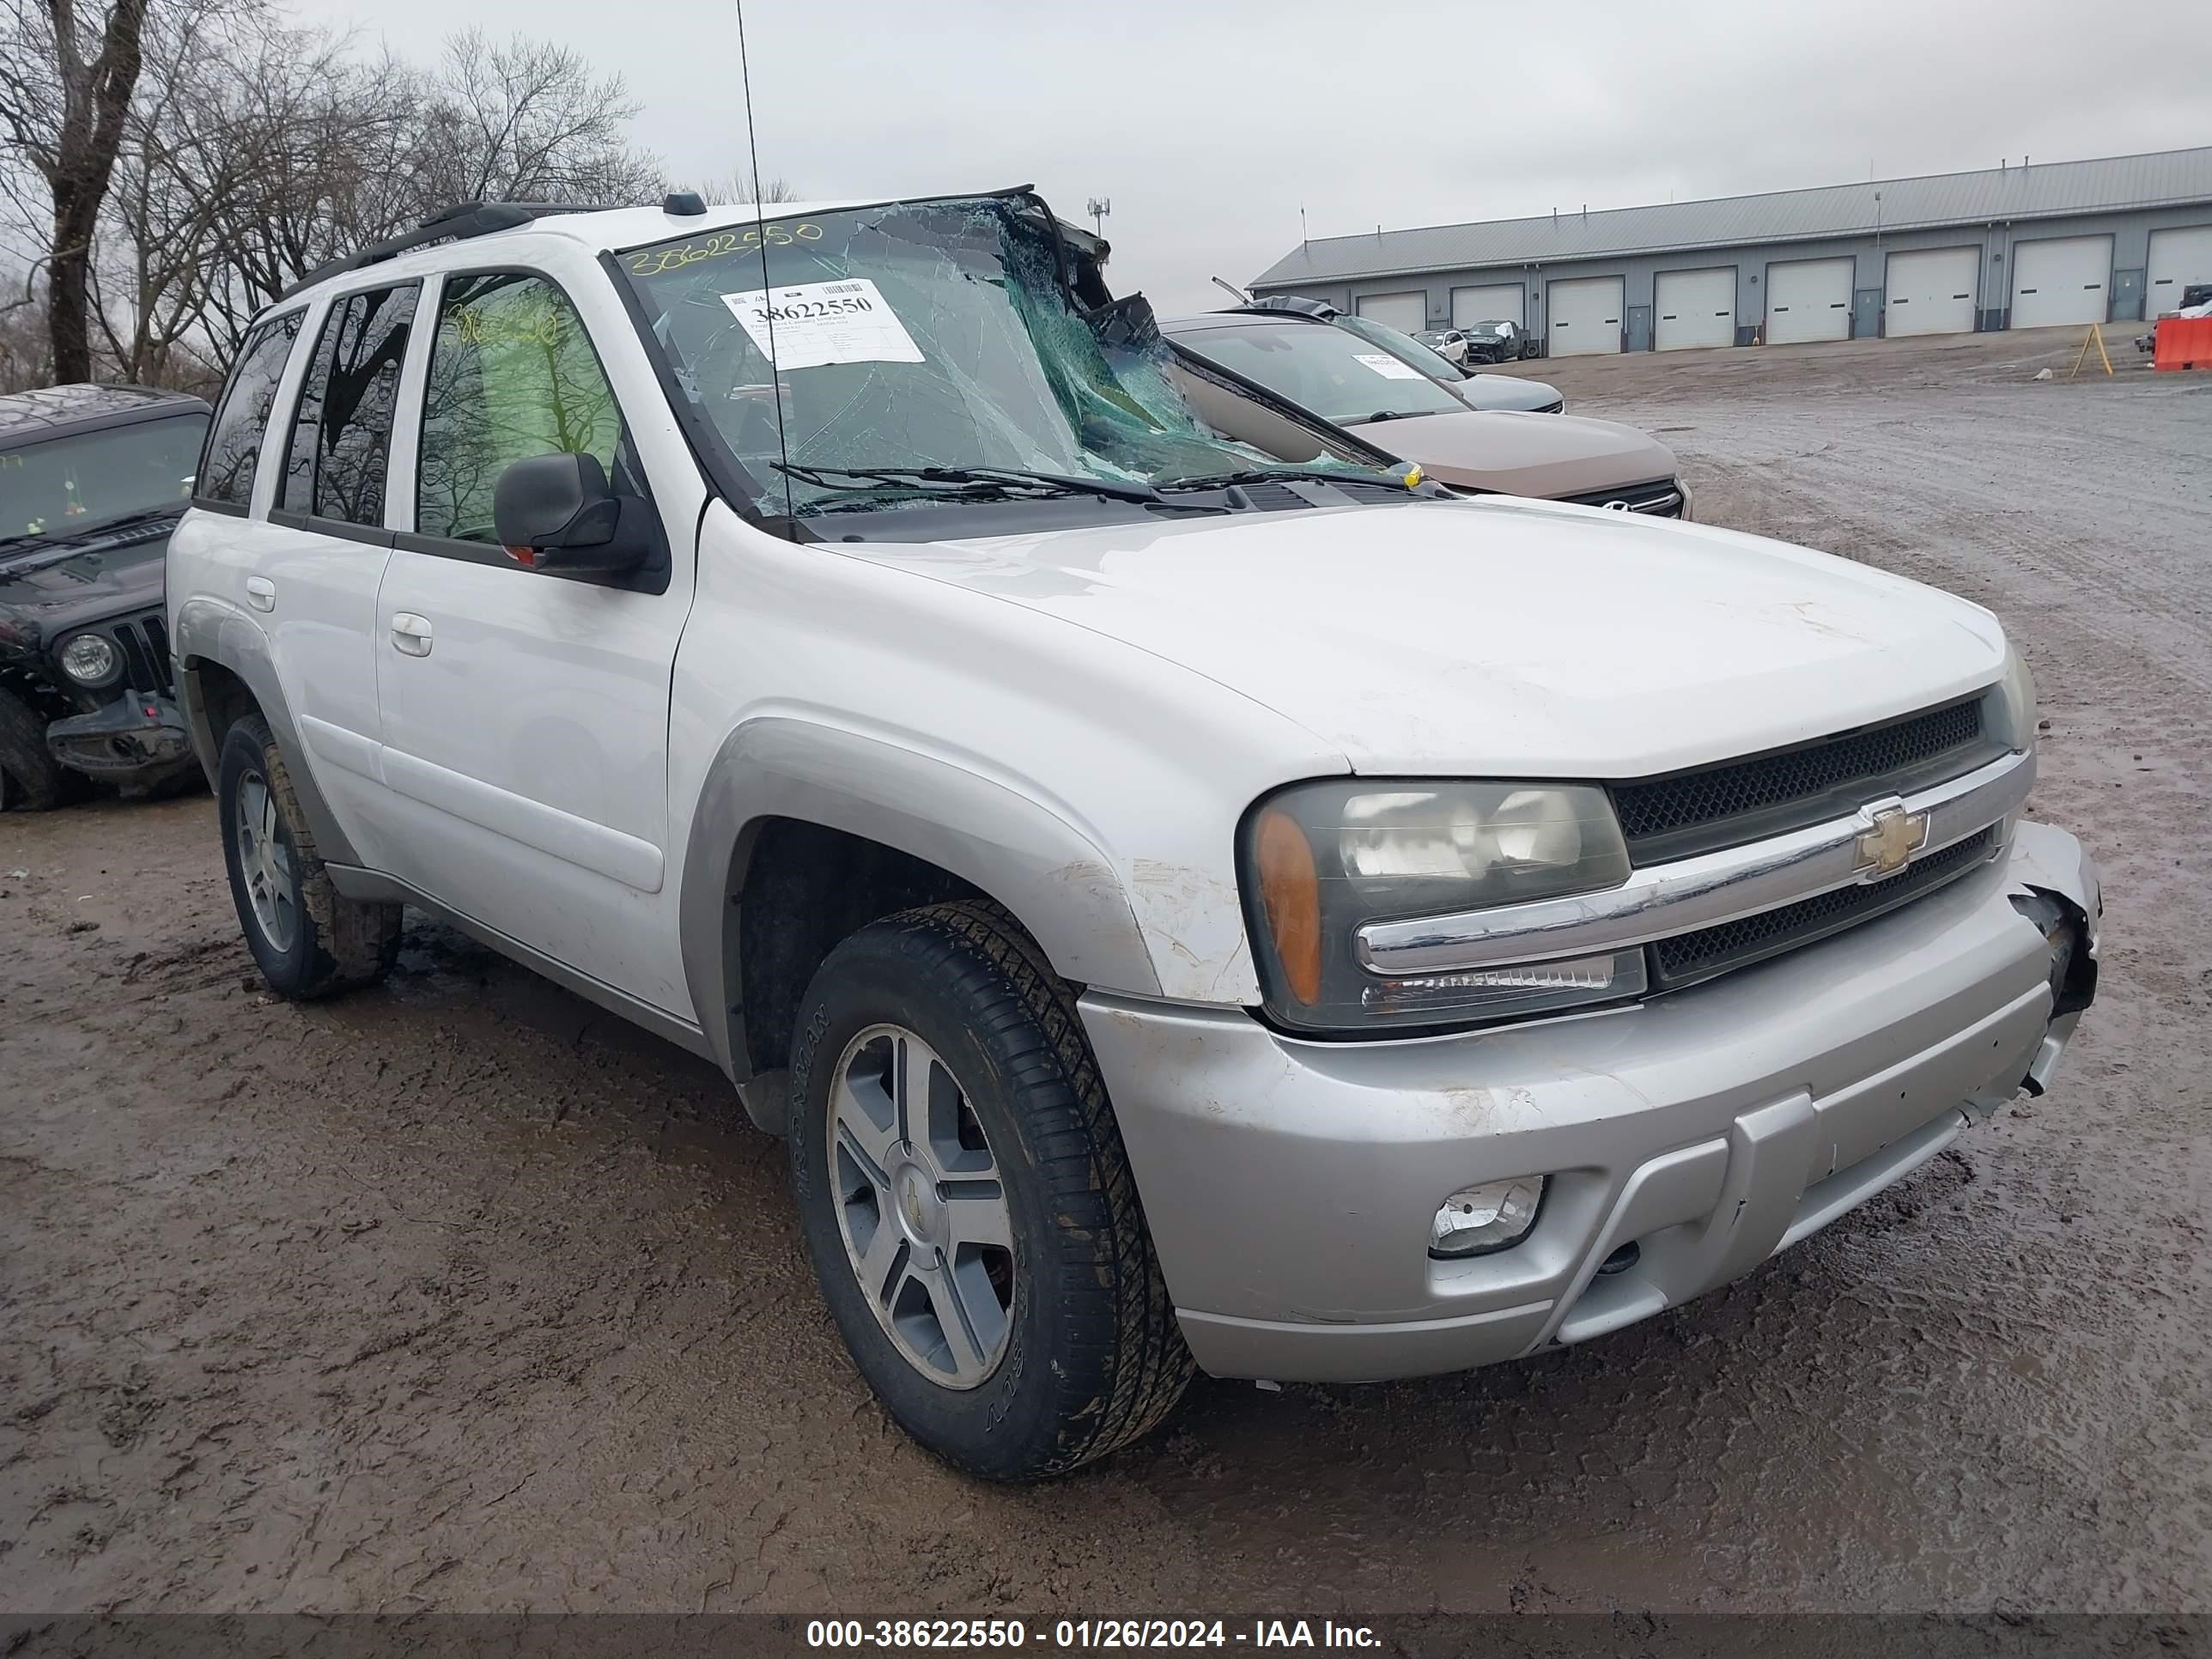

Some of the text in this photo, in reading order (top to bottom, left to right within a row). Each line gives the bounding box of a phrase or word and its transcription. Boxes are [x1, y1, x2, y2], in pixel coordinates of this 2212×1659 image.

[627, 224, 824, 277] 38622550
[750, 296, 873, 324] 38622550
[789, 1002, 832, 1200] IRONMAN
